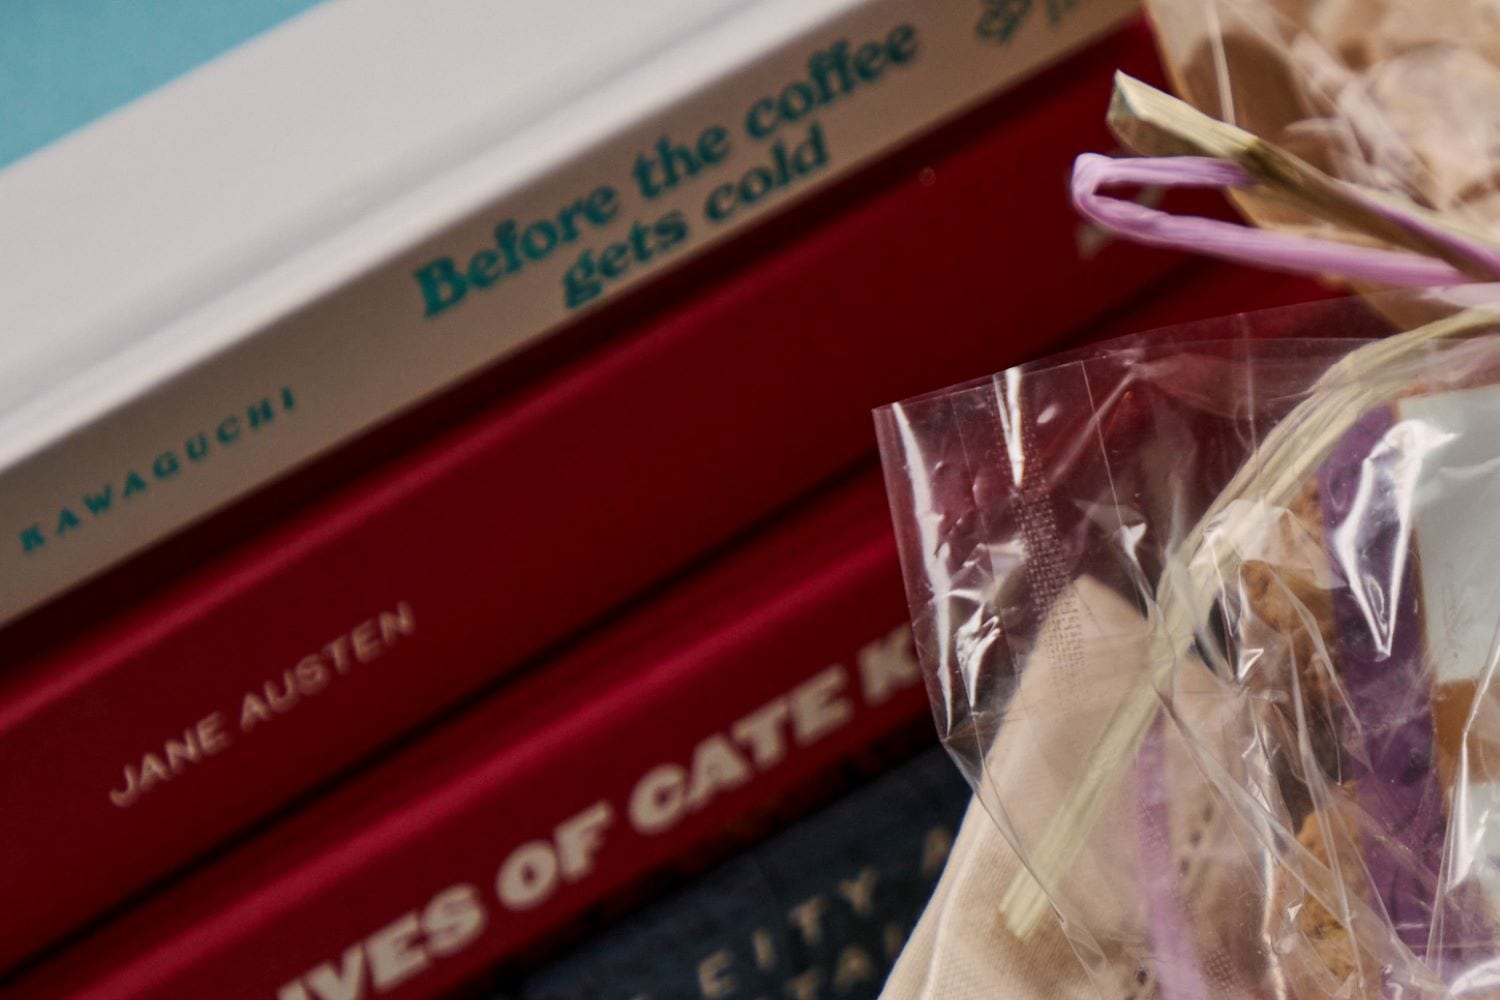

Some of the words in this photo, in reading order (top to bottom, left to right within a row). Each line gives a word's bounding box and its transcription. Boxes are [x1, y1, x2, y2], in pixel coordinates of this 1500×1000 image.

[411, 178, 619, 318] Before
[631, 119, 730, 200] the
[744, 22, 920, 143] coffee
[561, 207, 689, 308] gets
[705, 123, 831, 224] cold
[19, 386, 297, 554] KAWAGUCHI
[109, 711, 228, 807] JANE
[239, 601, 416, 731] AUSTEN
[496, 804, 614, 911] OF
[628, 665, 857, 834] CATE
